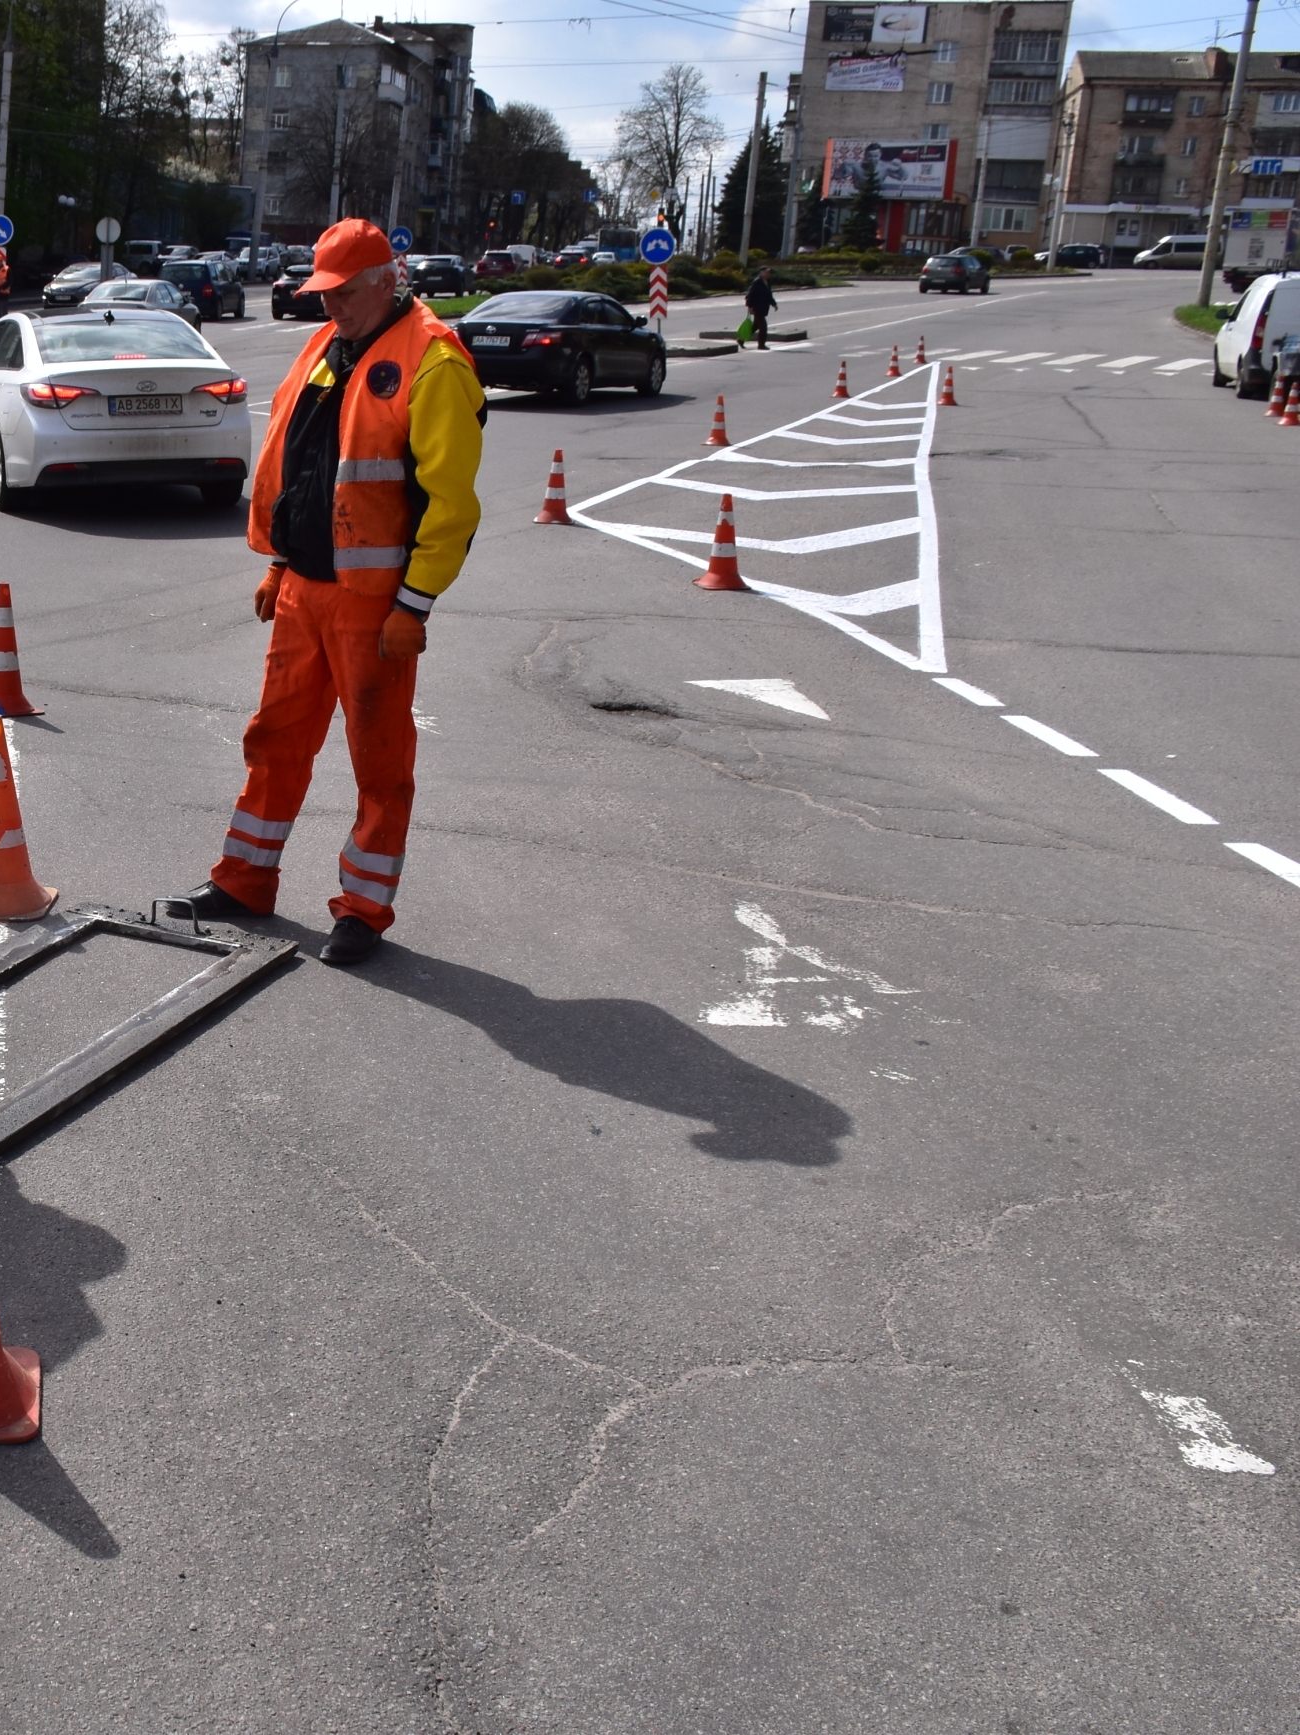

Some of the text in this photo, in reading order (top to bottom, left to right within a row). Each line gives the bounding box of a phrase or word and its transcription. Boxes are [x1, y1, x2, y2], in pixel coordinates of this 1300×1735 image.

[117, 397, 179, 411] AB 2568 IX
